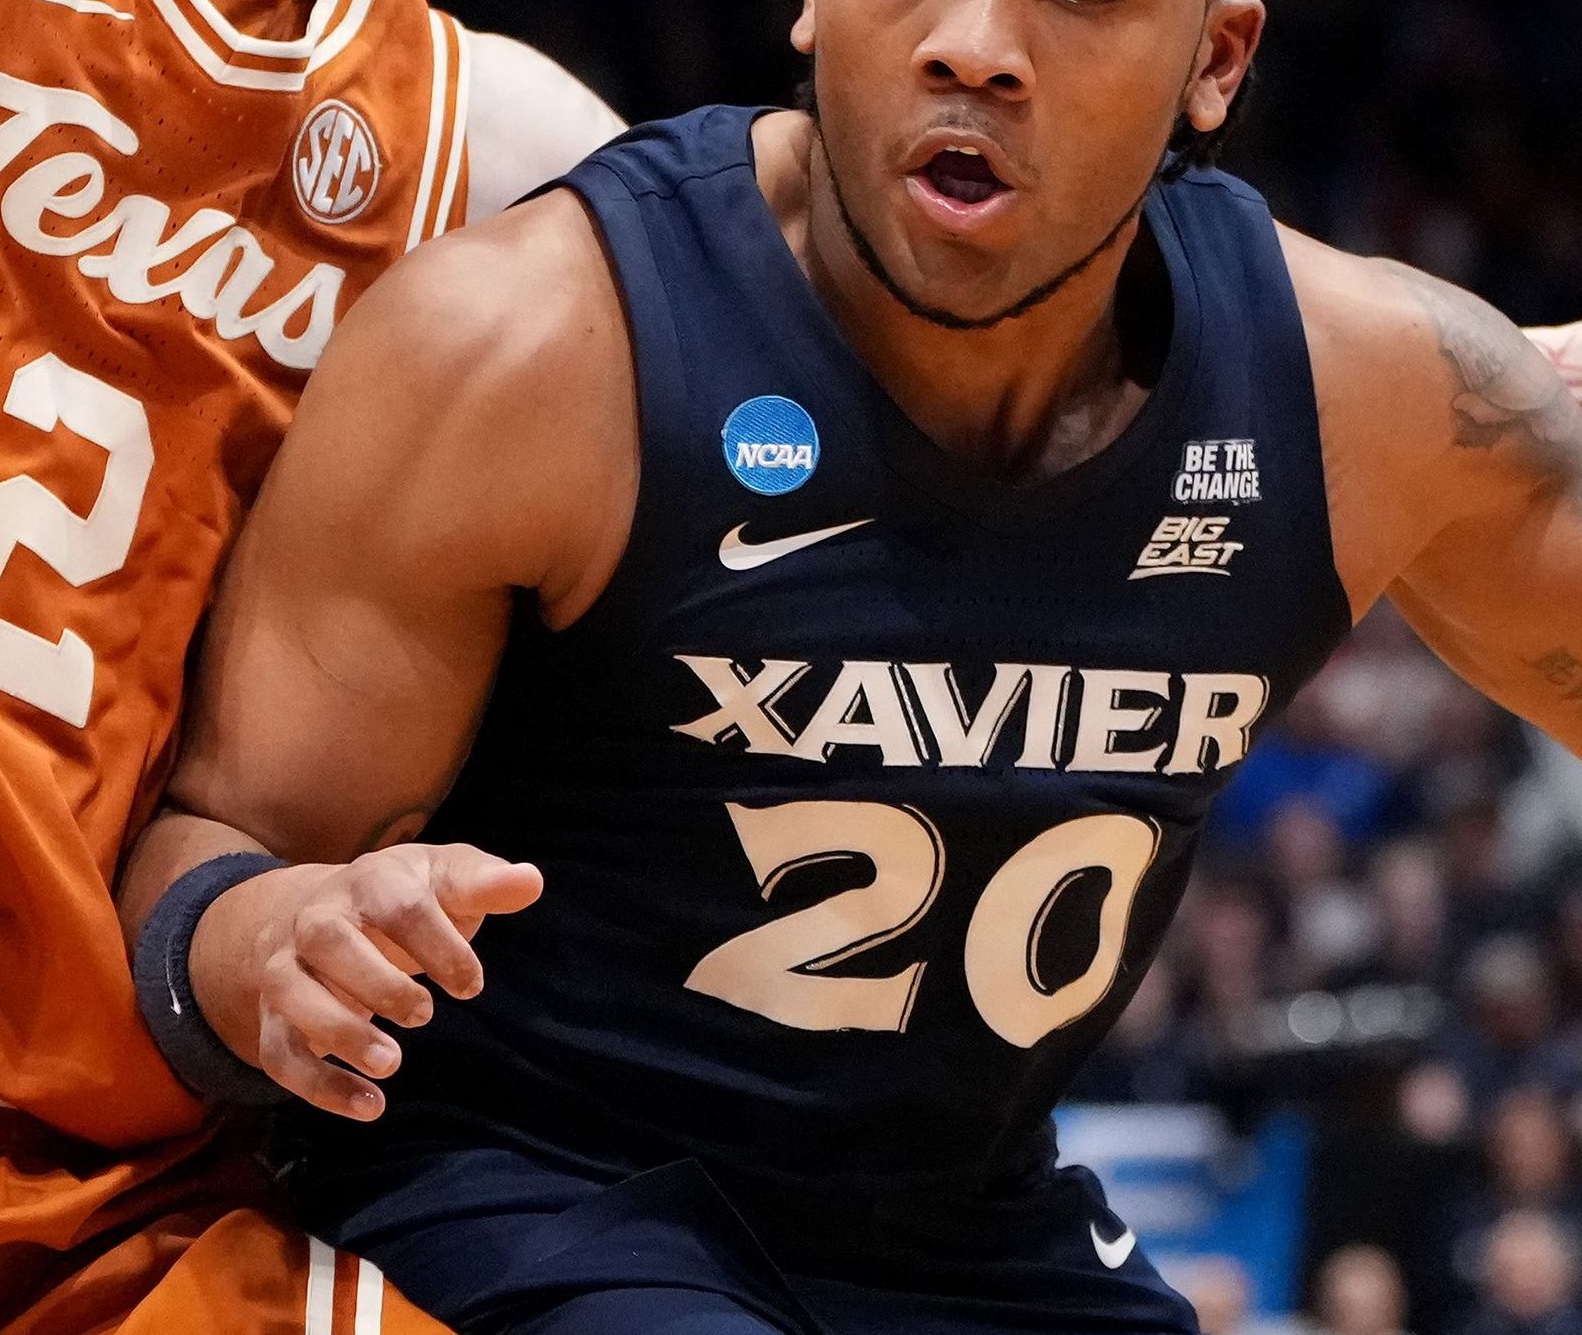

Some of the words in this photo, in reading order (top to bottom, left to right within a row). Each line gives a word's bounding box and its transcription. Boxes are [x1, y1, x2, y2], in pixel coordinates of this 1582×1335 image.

[297, 108, 373, 215] SEC
[735, 442, 813, 470] NCAA
[1185, 445, 1218, 472] BE
[1224, 443, 1256, 470] THE
[1175, 471, 1260, 501] CHANGE
[1150, 516, 1230, 542] BIG
[1137, 542, 1244, 566] EAST
[670, 655, 1270, 774] XAVIER
[683, 800, 1162, 1049] 20
